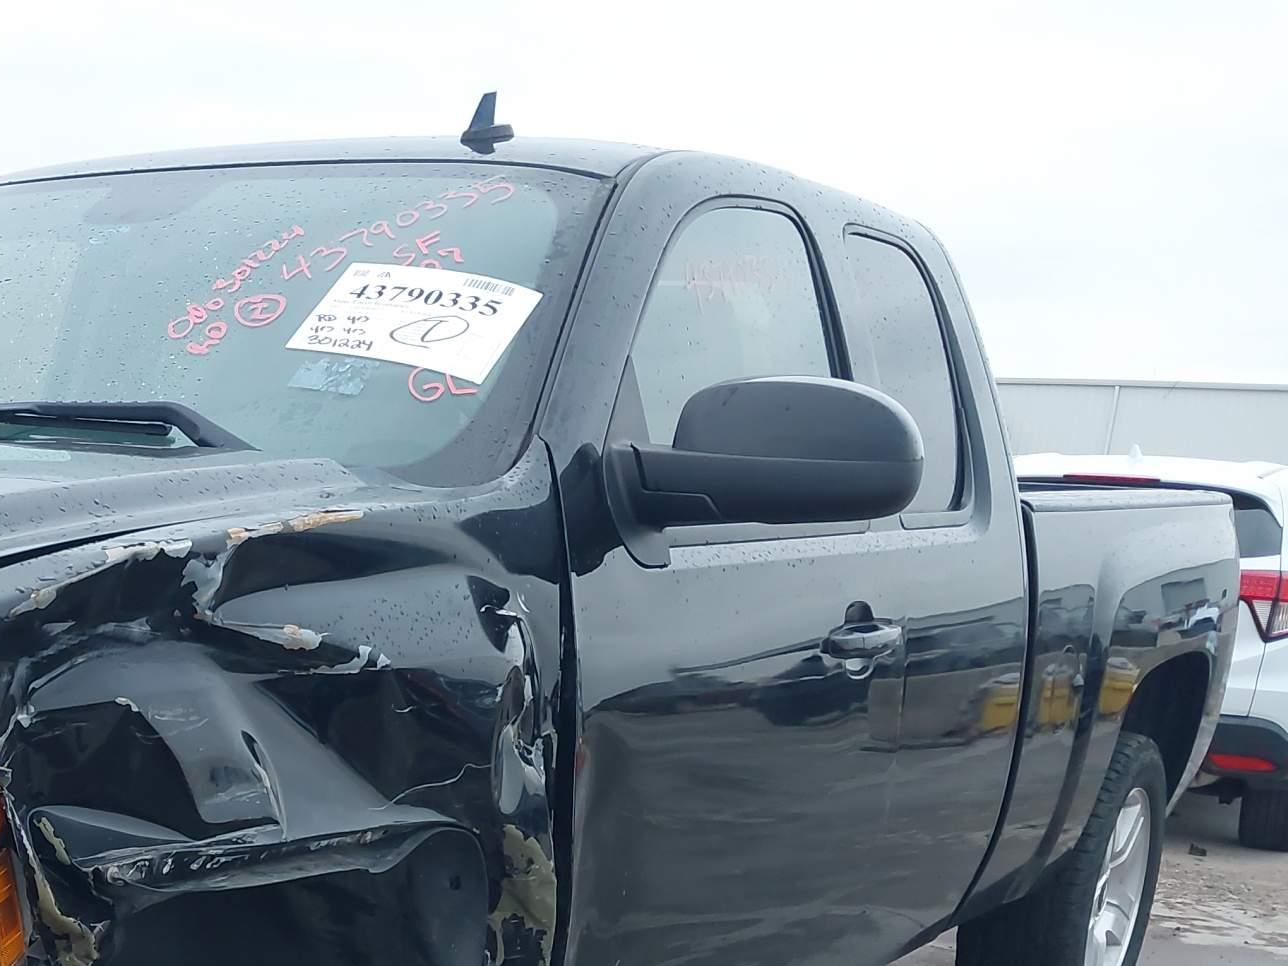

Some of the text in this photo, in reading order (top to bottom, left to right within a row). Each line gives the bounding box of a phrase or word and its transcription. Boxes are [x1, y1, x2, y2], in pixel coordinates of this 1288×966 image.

[280, 174, 515, 281] 43790335
[349, 284, 502, 317] 43790335
[307, 334, 374, 352] 301224
